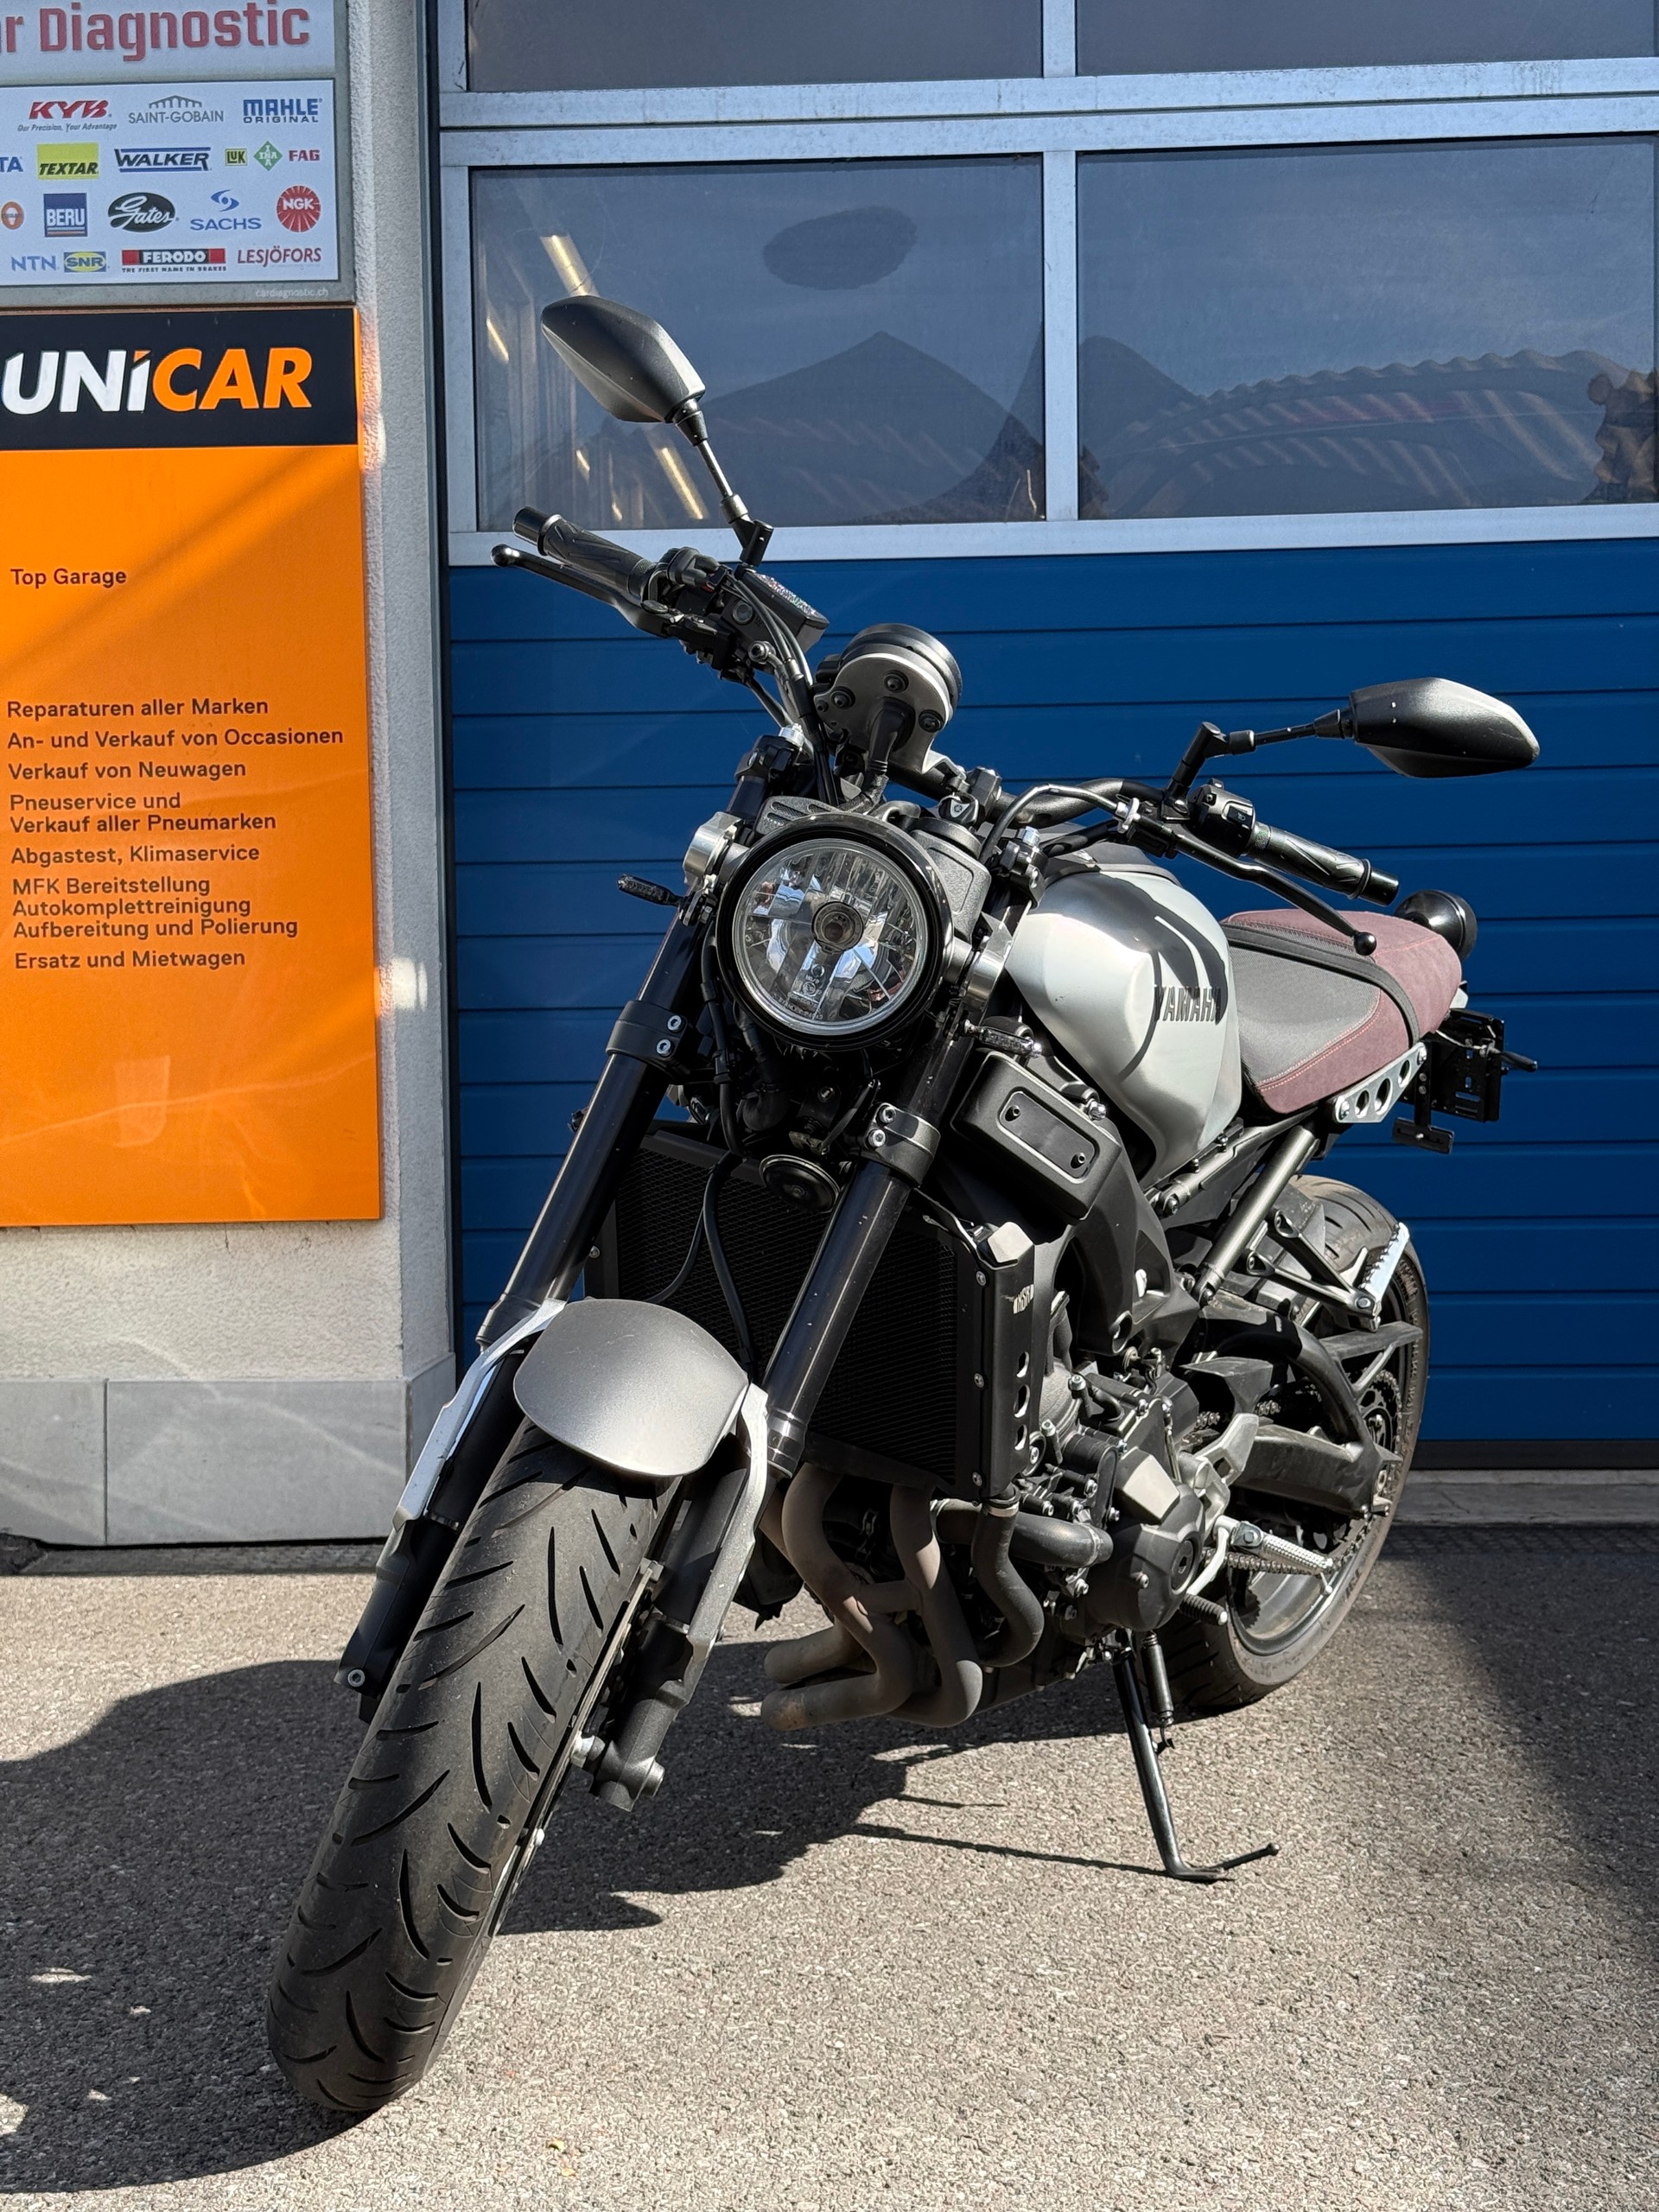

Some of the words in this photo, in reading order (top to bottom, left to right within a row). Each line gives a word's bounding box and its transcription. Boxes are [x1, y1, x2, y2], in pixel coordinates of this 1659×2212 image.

[0, 16, 24, 53] r
[40, 1, 309, 61] Diagnostic
[29, 100, 109, 119] KYB
[128, 111, 224, 124] SAINT-GOBAIN
[243, 99, 319, 116] MAHLE
[66, 123, 81, 132] Your
[82, 123, 118, 131] Advantage
[243, 115, 319, 124] ORIGINAL
[114, 149, 210, 171] WALKER
[289, 149, 321, 162] FAG
[39, 162, 99, 175] TEXTAR
[108, 195, 175, 228] Gates
[283, 198, 315, 211] NGK
[46, 208, 86, 226] BERU
[190, 218, 262, 231] SACHS
[11, 256, 56, 271] NTN
[67, 257, 104, 267] SNR
[143, 251, 207, 264] FERODO
[238, 245, 321, 268] LESJÖFORS
[10, 569, 47, 588] Top
[53, 568, 127, 588] Garage
[8, 701, 134, 721] Reparaturen
[141, 698, 184, 715] aller
[192, 698, 269, 715] Marken
[8, 733, 43, 749] An-
[51, 731, 88, 747] und
[95, 730, 175, 747] Verkauf
[181, 732, 218, 747] von
[224, 728, 344, 746] Occasionen
[8, 763, 88, 780] Verkauf
[95, 765, 131, 779] von
[139, 761, 246, 781] Neuwagen
[10, 793, 137, 810] Pneuservice
[143, 792, 181, 809] und
[10, 817, 91, 833] Verkauf
[96, 815, 140, 832] aller
[148, 813, 276, 830] Pneumarken
[11, 847, 123, 868] Abgastest,
[130, 845, 260, 862] Klimaservice
[13, 879, 60, 895] MFK
[67, 876, 211, 896] Bereitstellung
[13, 897, 251, 919] Autokomplettreinigung
[14, 920, 149, 940] Aufbereitung
[156, 919, 194, 936] und
[200, 918, 298, 938] Polierung
[15, 952, 81, 969] Ersatz
[86, 951, 124, 968] und
[132, 950, 245, 970] Mietwagen
[1154, 985, 1222, 1023] YAMAHA
